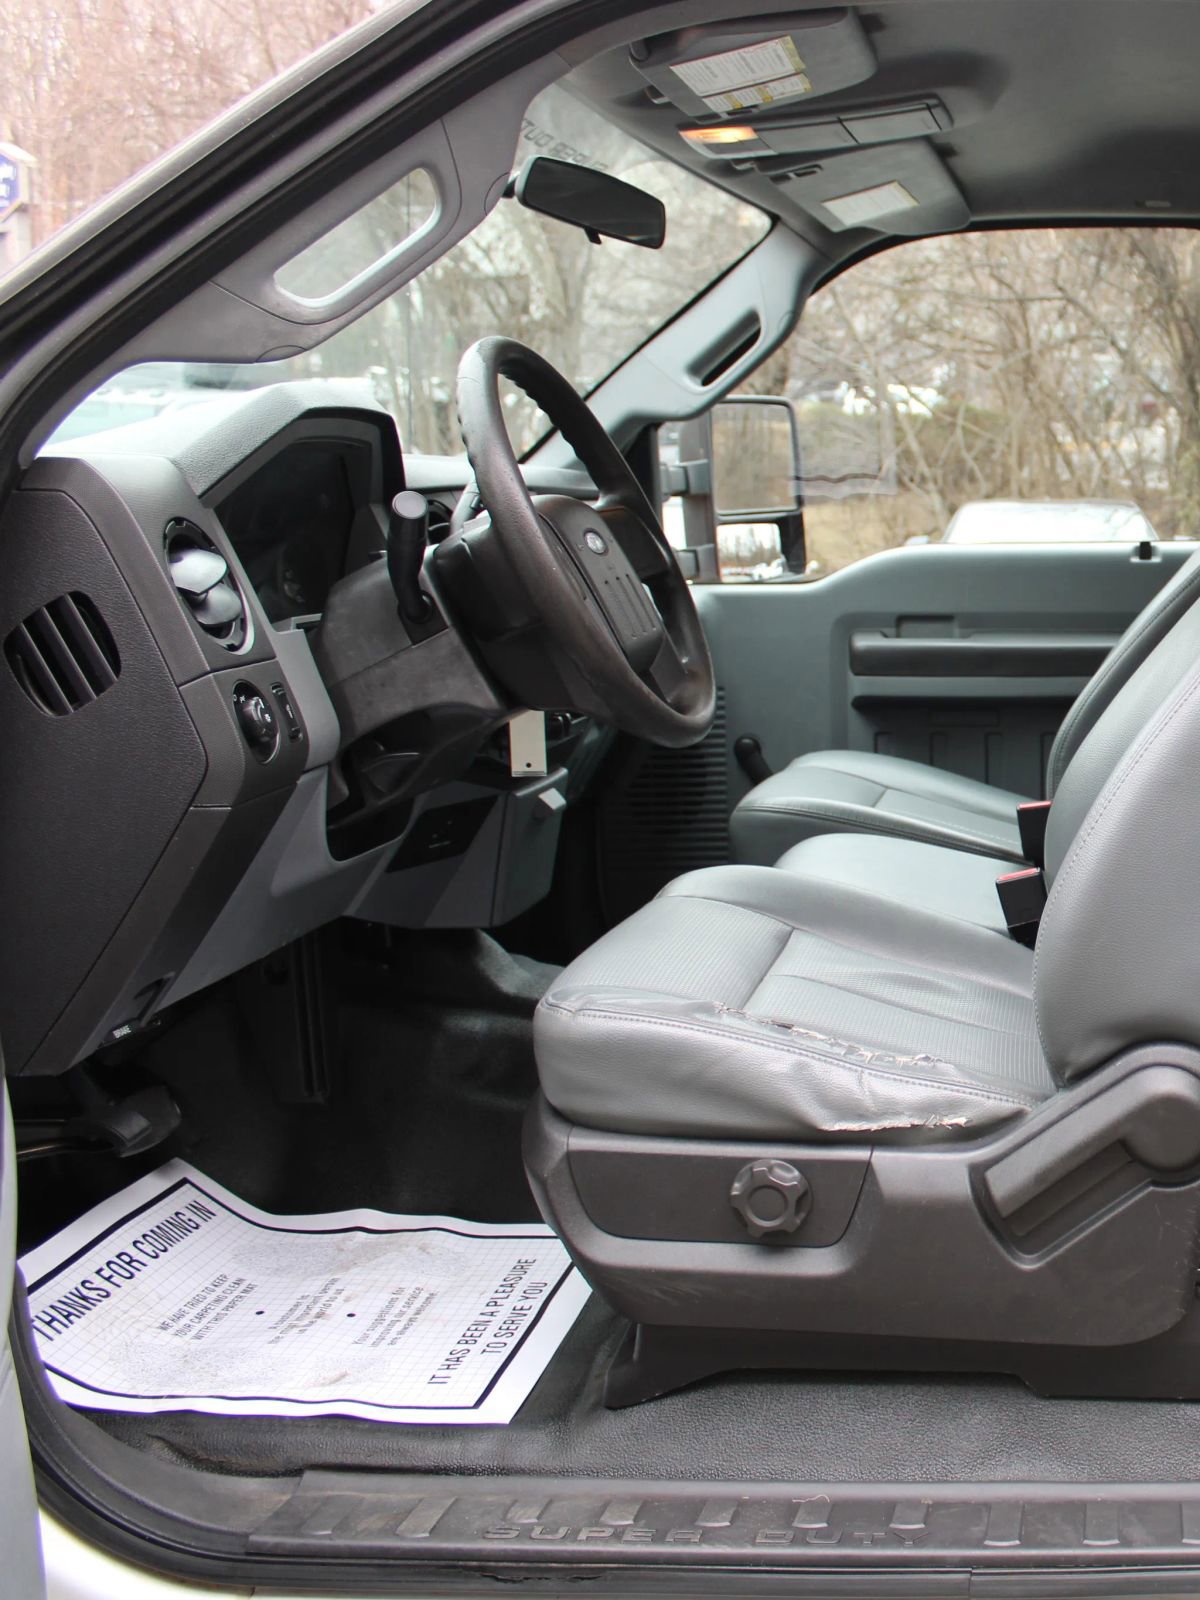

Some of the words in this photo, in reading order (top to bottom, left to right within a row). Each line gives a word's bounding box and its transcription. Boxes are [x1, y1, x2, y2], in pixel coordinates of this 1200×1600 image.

[31, 1279, 112, 1342] THANKS
[94, 1251, 148, 1289] FOR
[132, 1211, 202, 1259] COMING
[185, 1199, 217, 1223] IN
[485, 1258, 537, 1308] PLEASURE
[157, 1320, 174, 1331] WE
[167, 1308, 189, 1323] HAVE
[183, 1293, 207, 1309] TRIED
[201, 1286, 216, 1295] TO
[211, 1273, 229, 1288] KEEP
[517, 1281, 548, 1302] YOU
[172, 1323, 194, 1337] YOUR
[190, 1294, 228, 1324] CARPETING
[222, 1277, 246, 1295] CLEAN
[190, 1325, 215, 1340] WITH
[206, 1311, 228, 1325] THIS
[221, 1294, 247, 1312] PAPER
[240, 1283, 259, 1294] MAT
[479, 1309, 501, 1318] A
[456, 1319, 493, 1345] BEEN
[493, 1304, 533, 1339] SERVE
[437, 1348, 470, 1371] HAS
[480, 1341, 508, 1355] TO
[427, 1374, 451, 1384] IT
[482, 1525, 703, 1544] SUPER
[755, 1527, 929, 1546] DUTY
